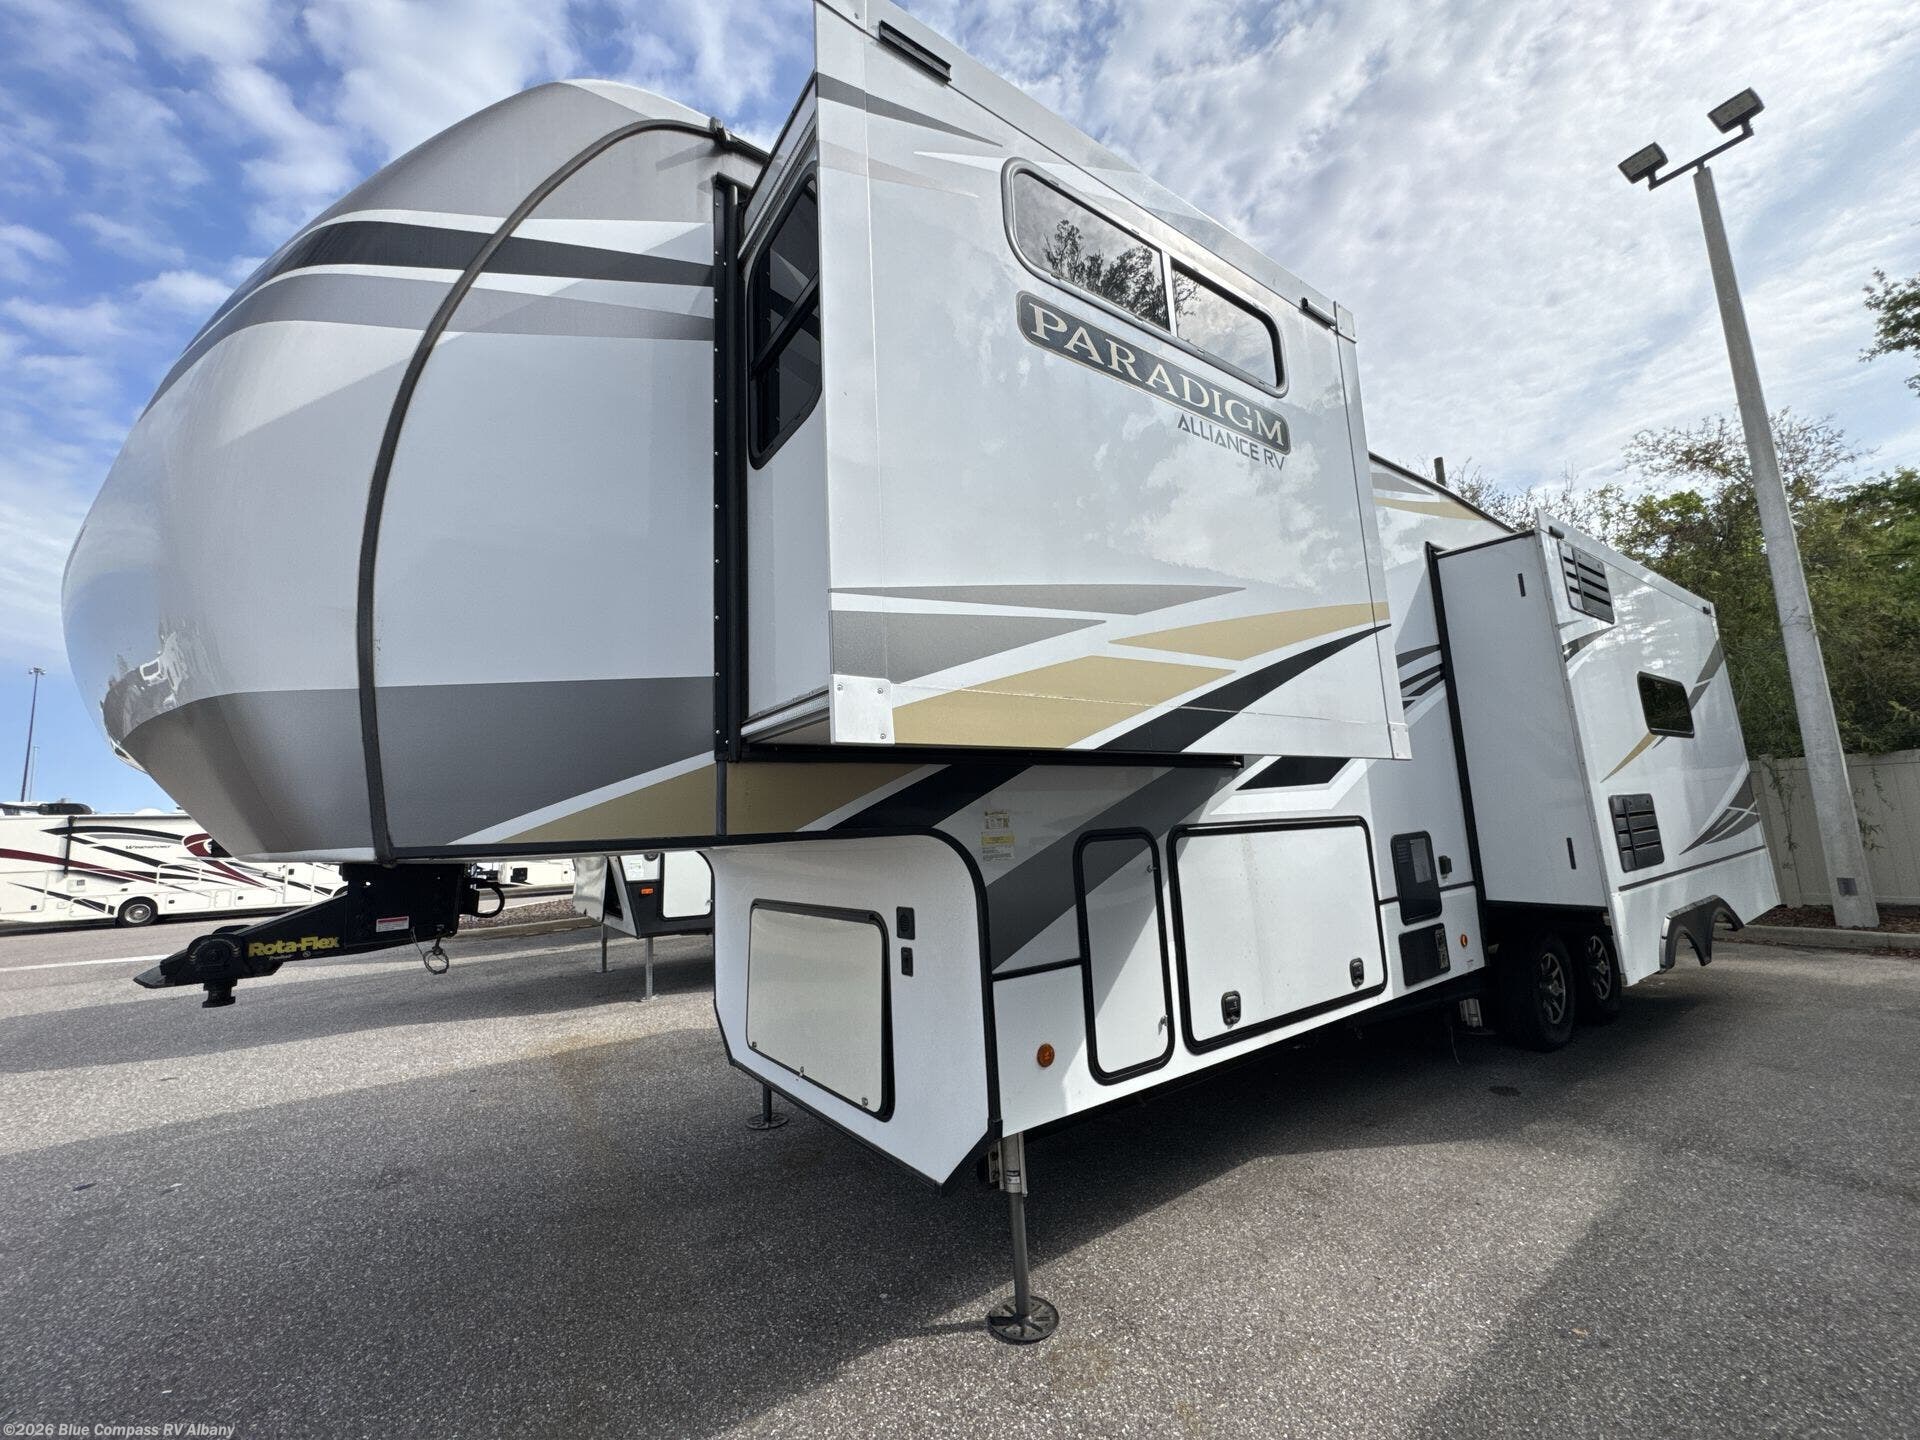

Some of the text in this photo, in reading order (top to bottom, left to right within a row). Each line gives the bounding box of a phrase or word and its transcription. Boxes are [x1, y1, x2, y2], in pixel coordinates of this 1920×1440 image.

[1029, 302, 1286, 447] PARADIGM
[1177, 413, 1285, 471] ALLIANCE RV
